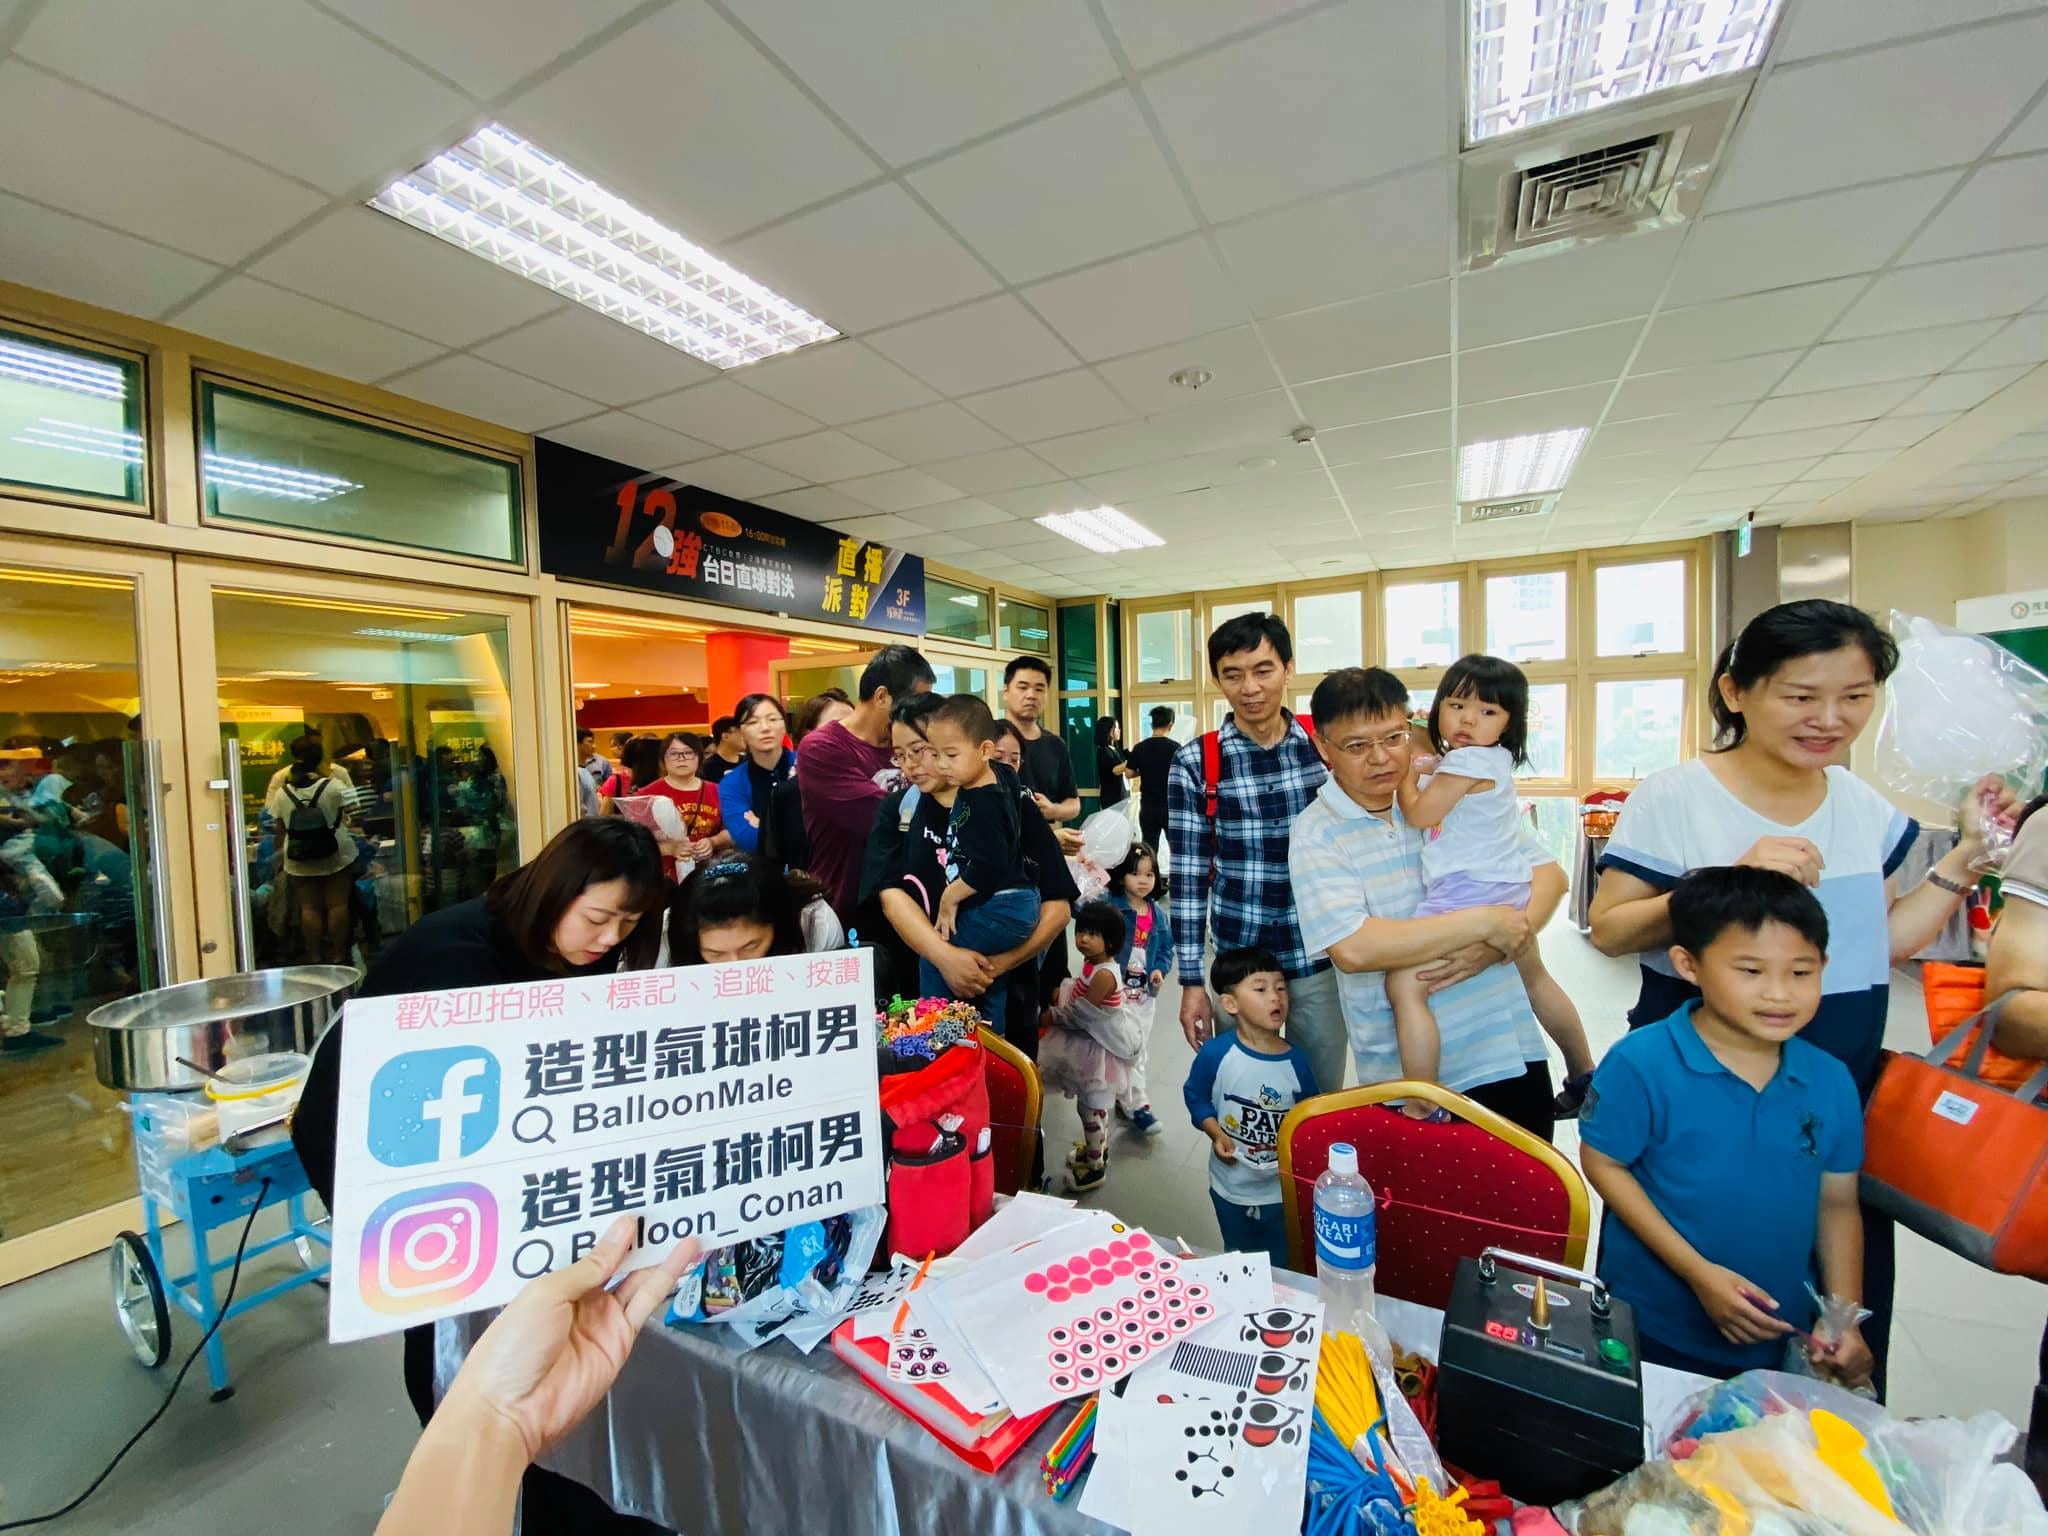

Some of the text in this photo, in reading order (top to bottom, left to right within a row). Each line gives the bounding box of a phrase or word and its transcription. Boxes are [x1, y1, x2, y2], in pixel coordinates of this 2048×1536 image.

[702, 554, 795, 599] 台日直球對決
[837, 537, 883, 584] 直播
[822, 575, 869, 620] 派對
[896, 588, 910, 607] 3F
[523, 1004, 858, 1099] 造型氣球柯男
[573, 1074, 793, 1133] BalloonMale
[1240, 1125, 1277, 1144] PATR
[520, 1111, 863, 1232] 造型氣球柯男
[572, 1181, 843, 1264] Bloon_Conan
[1314, 1208, 1358, 1234] OCARI
[1316, 1222, 1353, 1244] WEAT
